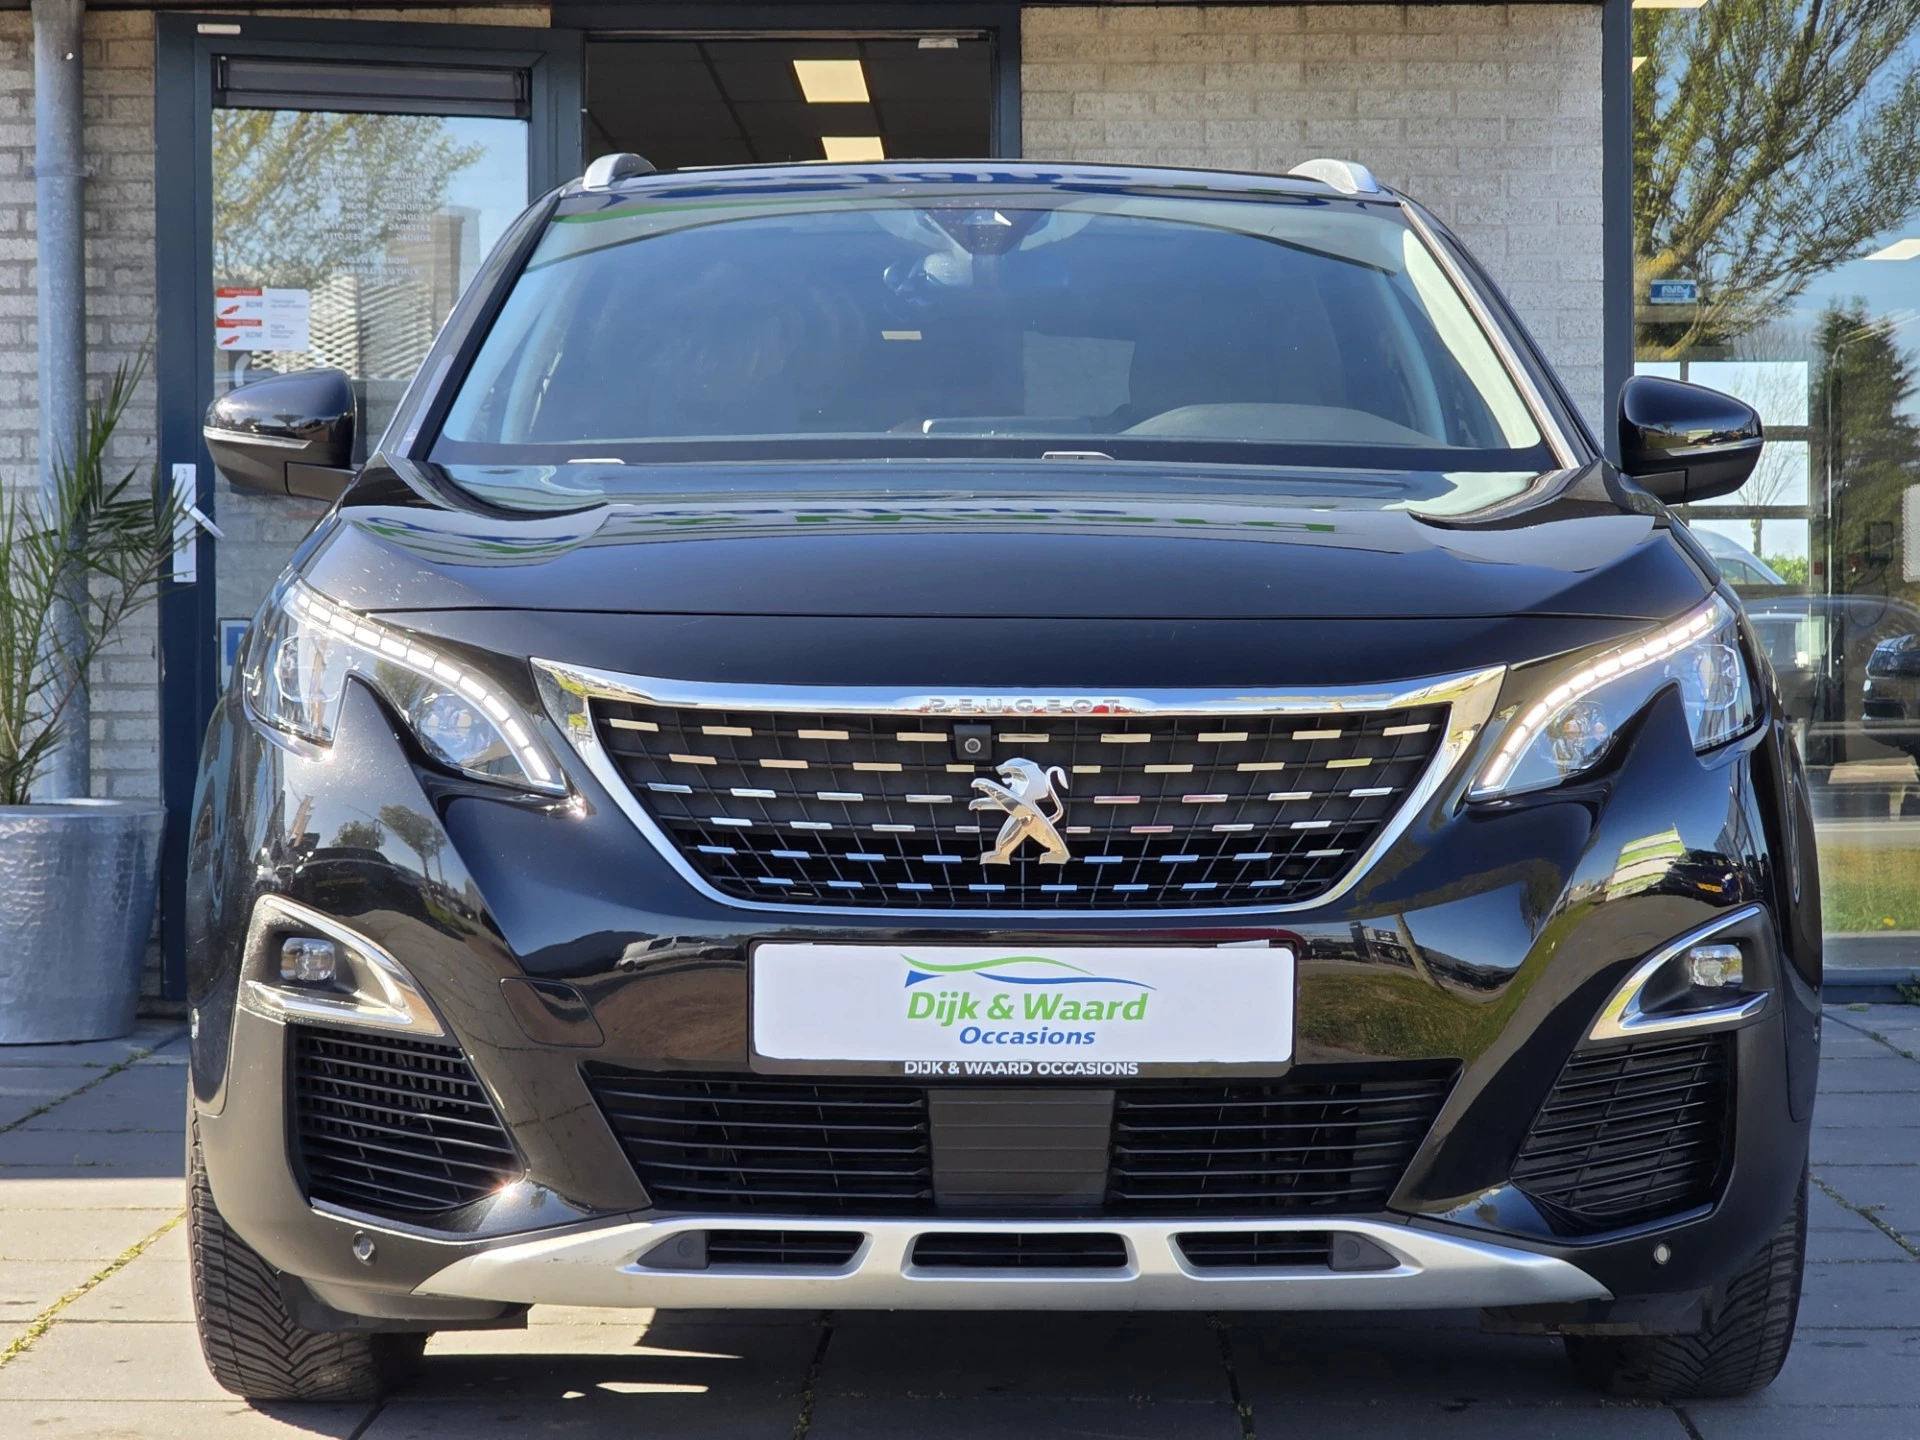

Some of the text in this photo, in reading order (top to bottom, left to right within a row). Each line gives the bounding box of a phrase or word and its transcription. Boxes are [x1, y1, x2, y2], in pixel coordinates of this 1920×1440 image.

[929, 698, 1120, 713] PEUGEOT
[907, 991, 1149, 1027] Dijk & Waard
[959, 1026, 1096, 1045] Occasions
[904, 1061, 1139, 1076] DIJK & WAARD OCCASIONS
